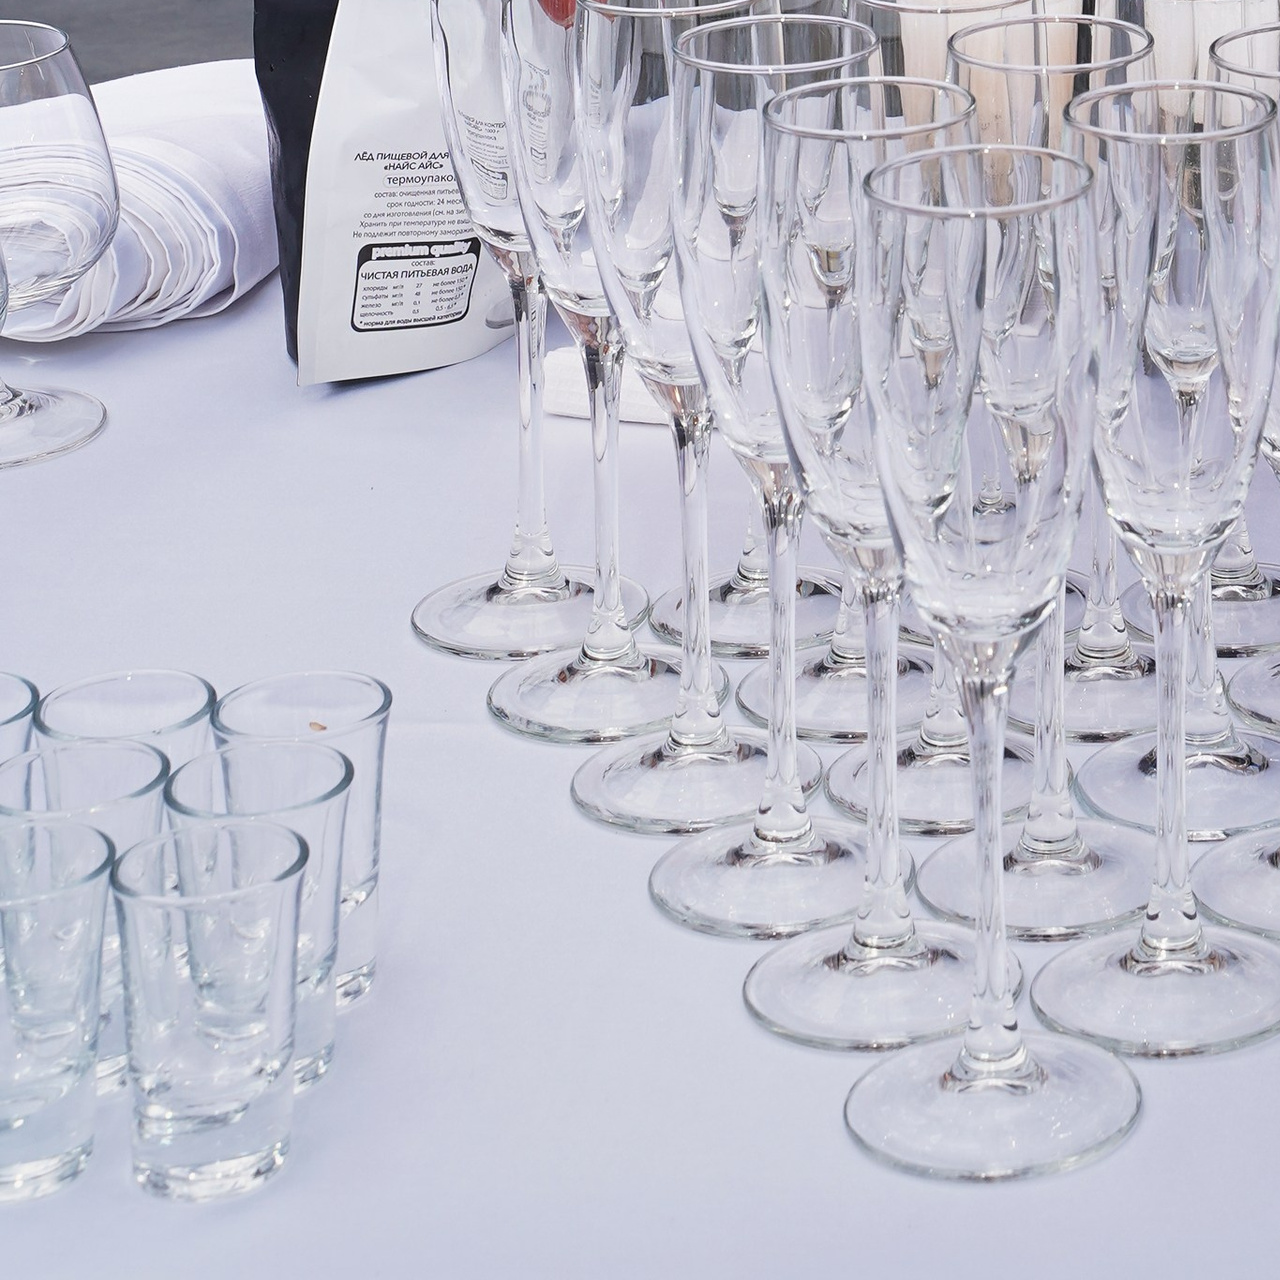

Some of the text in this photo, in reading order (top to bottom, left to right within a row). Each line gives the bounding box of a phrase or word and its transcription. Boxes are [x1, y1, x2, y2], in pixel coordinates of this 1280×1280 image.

[354, 151, 450, 161] ЛЁД ПИЩЕВОЙ ДЛЯ
[387, 173, 457, 186] термоупако
[371, 243, 430, 260] premium
[361, 263, 474, 281] ЧИСТАЯ ПИТЬЕВАЯ ВОДА
